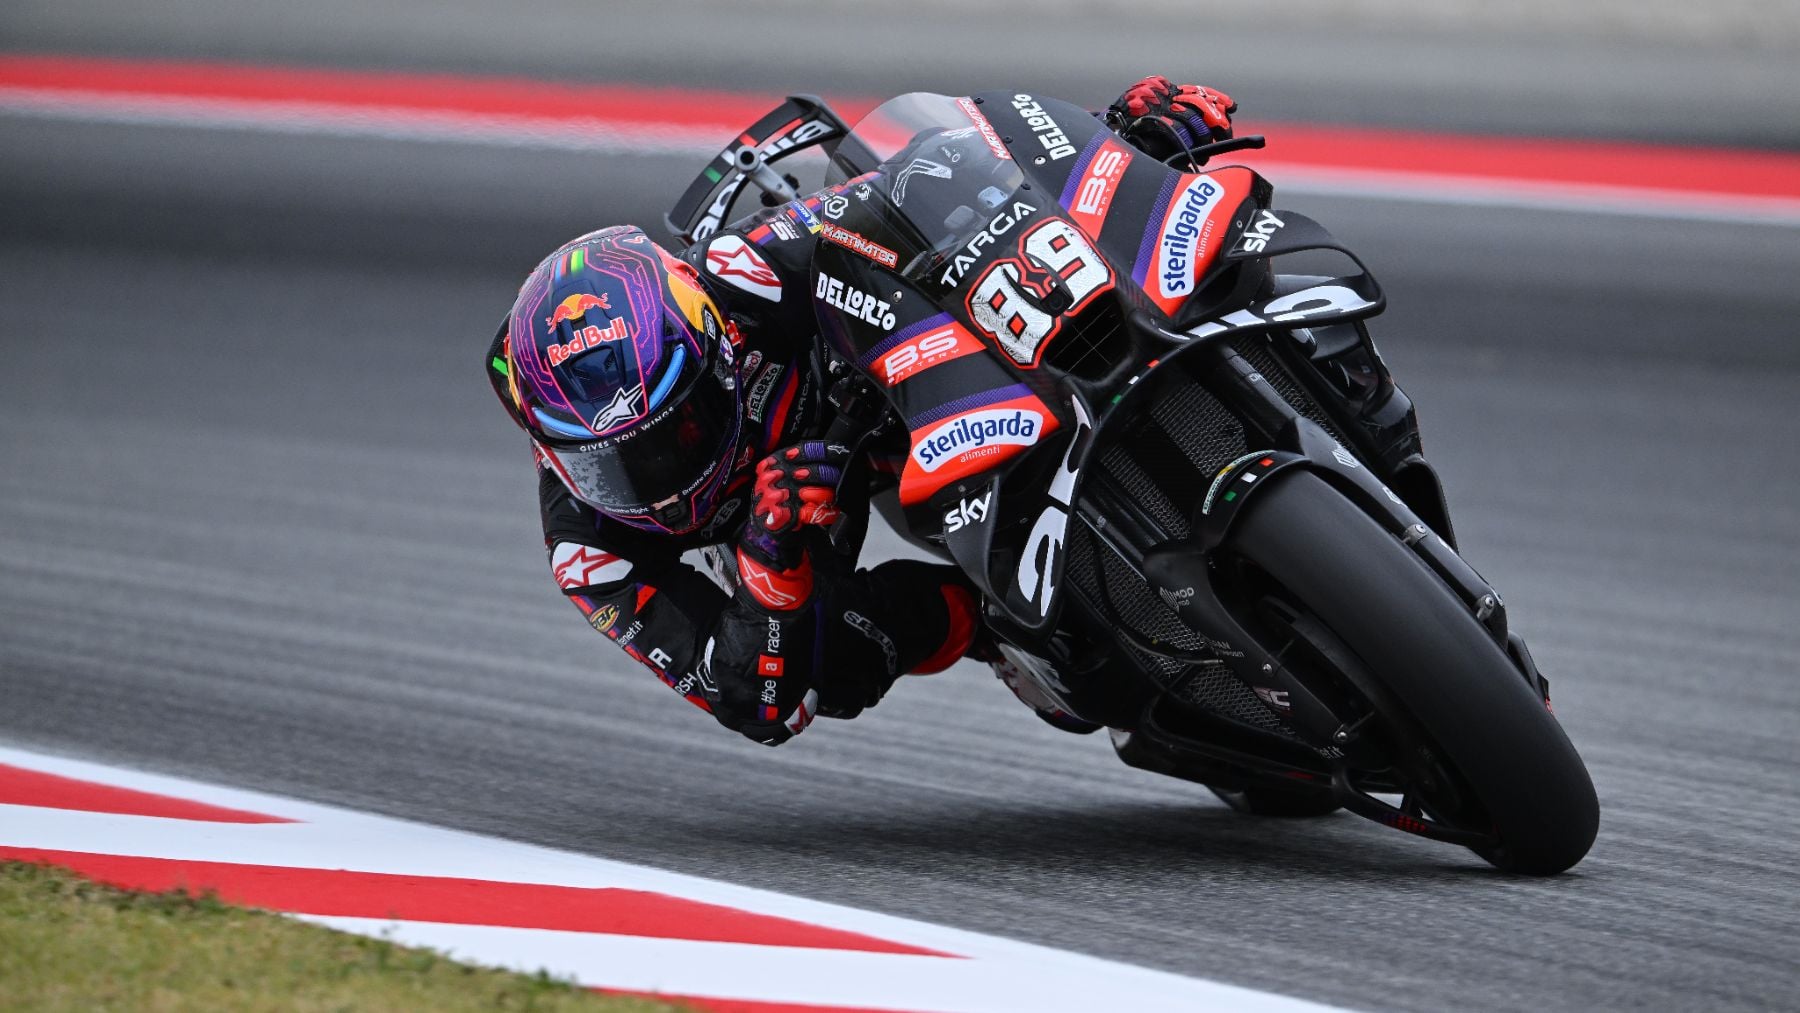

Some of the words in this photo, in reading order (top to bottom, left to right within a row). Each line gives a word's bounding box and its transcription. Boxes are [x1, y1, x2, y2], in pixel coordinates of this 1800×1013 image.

[1010, 94, 1077, 160] DELLORTO
[1075, 150, 1123, 215] BS
[822, 221, 899, 269] MARTINATOR
[940, 201, 1037, 288] TARGA
[1163, 182, 1216, 292] sterilgarda
[1198, 219, 1215, 258] alimenti
[1243, 209, 1285, 252] sky
[816, 271, 896, 331] DELLORTO
[966, 216, 1116, 369] 89
[547, 329, 585, 367] Red
[583, 316, 628, 349] Bull
[884, 328, 958, 378] BS
[580, 440, 609, 452] GIVES
[614, 429, 637, 443] YOU
[641, 406, 674, 431] WINGS
[919, 411, 1035, 464] sterilgarda
[960, 444, 1000, 463] alimenti
[945, 491, 992, 533] sky
[768, 616, 780, 653] racer
[761, 679, 777, 704] #be
[765, 662, 778, 672] a
